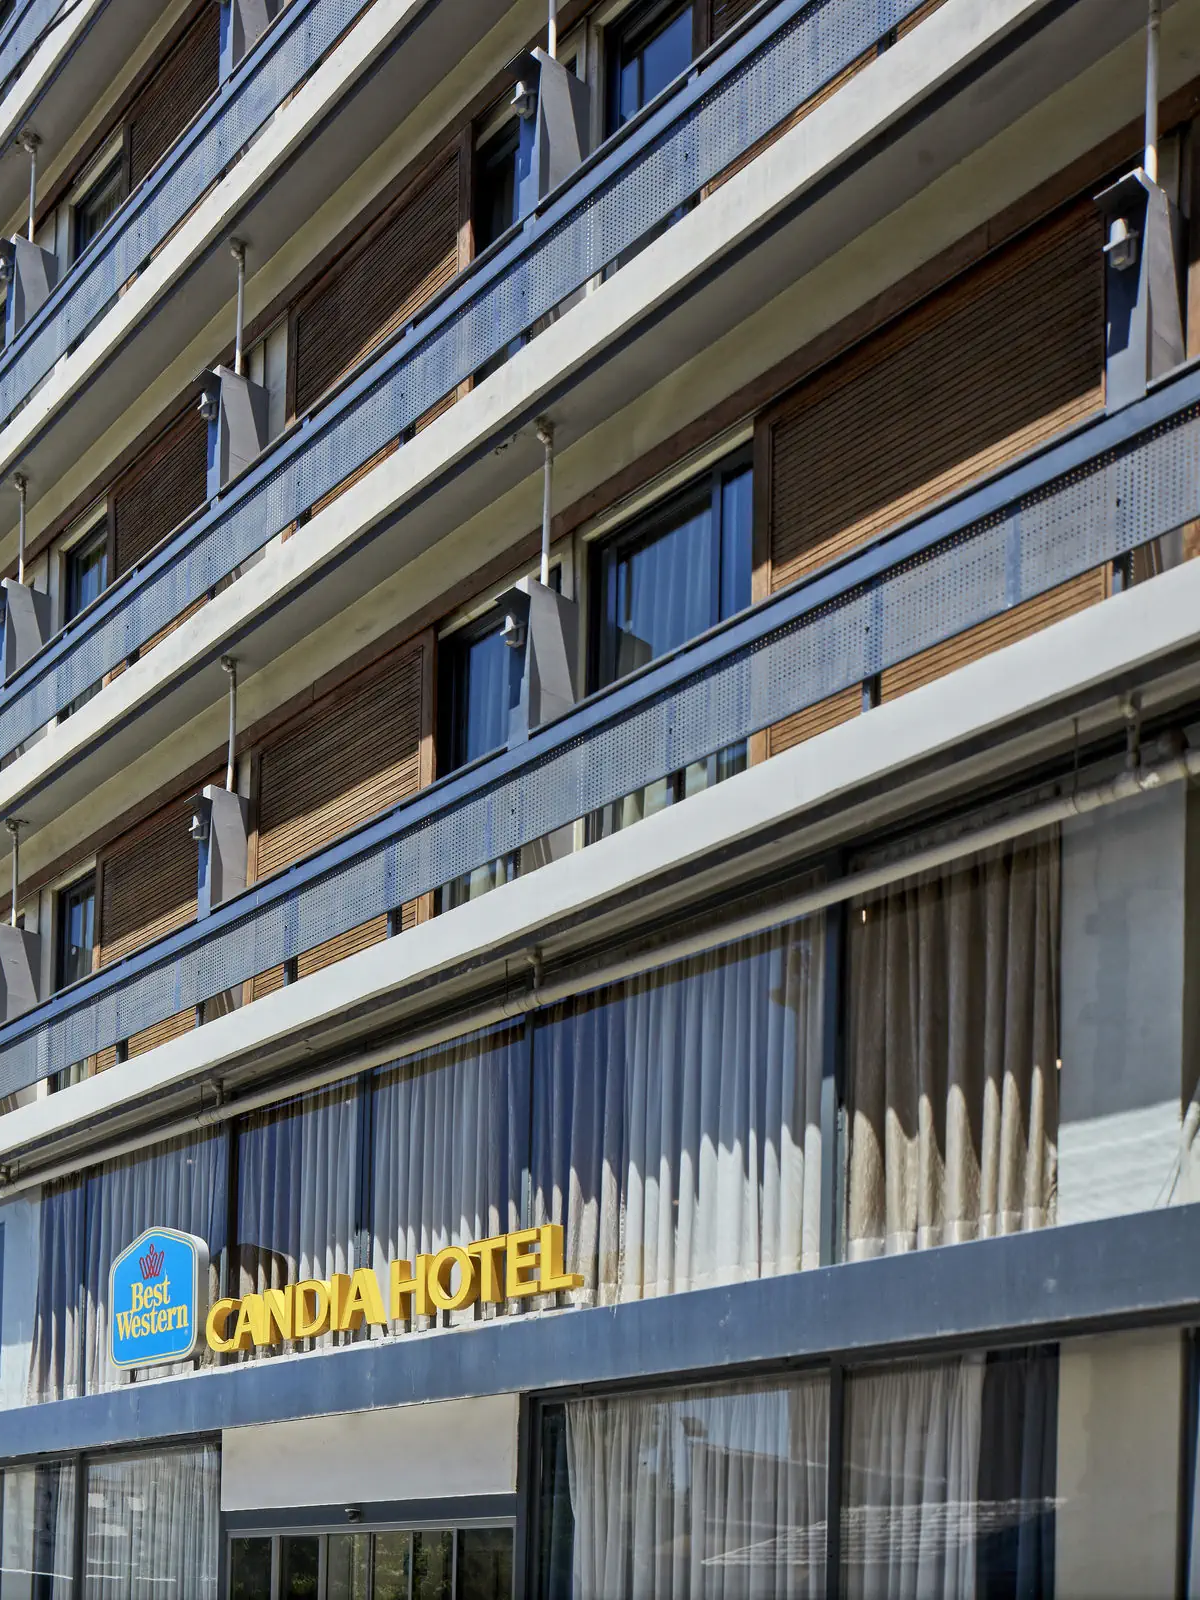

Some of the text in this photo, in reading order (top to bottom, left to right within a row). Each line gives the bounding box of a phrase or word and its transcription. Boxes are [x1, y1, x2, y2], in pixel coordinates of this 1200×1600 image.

[131, 1271, 171, 1313] Best
[206, 1224, 584, 1353] CANDIA HOTEL
[116, 1303, 189, 1341] Western
